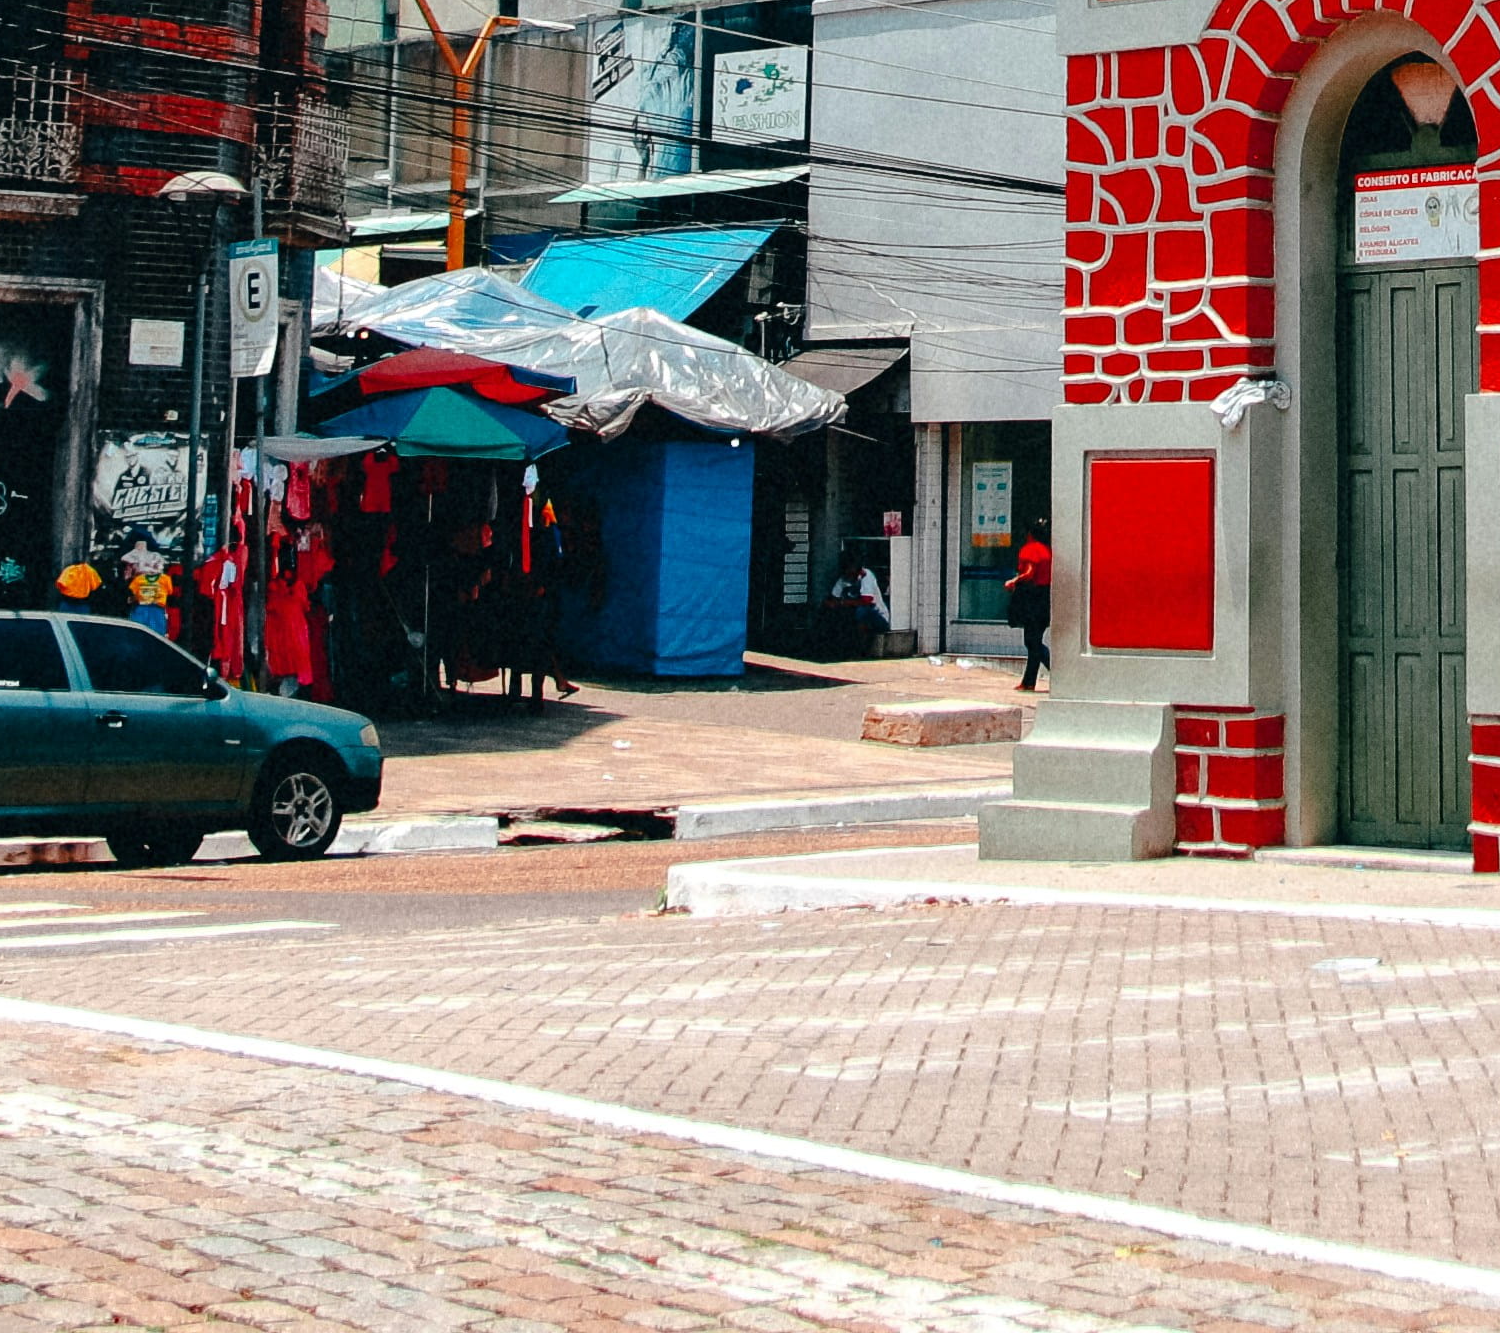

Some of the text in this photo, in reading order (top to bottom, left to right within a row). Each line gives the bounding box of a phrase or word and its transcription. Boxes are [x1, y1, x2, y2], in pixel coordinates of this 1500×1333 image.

[1357, 173, 1410, 188] CONSERTO
[1411, 173, 1419, 184] E
[247, 272, 261, 310] E
